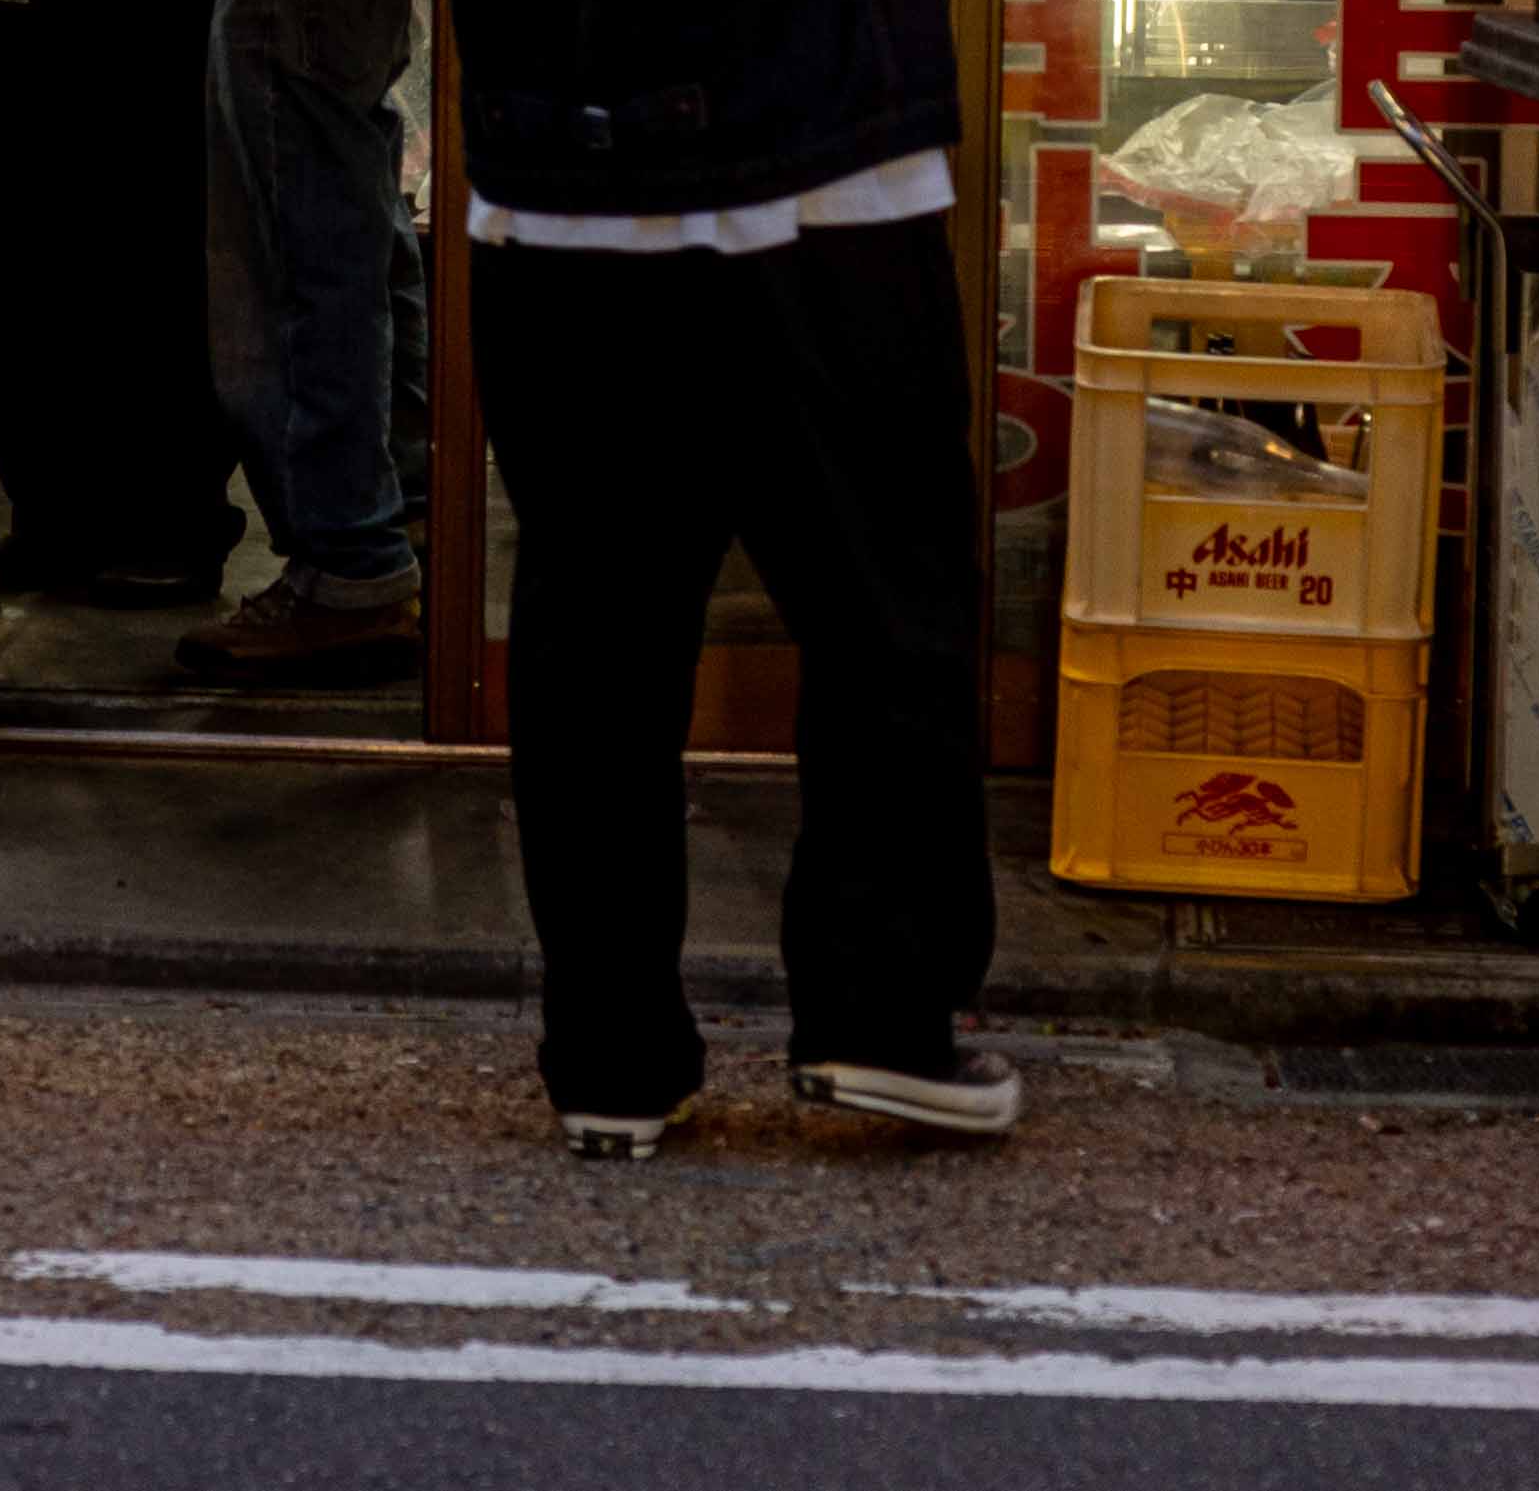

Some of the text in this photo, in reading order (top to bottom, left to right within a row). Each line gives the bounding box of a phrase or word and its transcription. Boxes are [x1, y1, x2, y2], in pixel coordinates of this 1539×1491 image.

[1191, 522, 1311, 570] Asahi
[1164, 567, 1199, 601] 中
[1207, 570, 1289, 591] ASAHI BEER
[1298, 574, 1334, 606] 20
